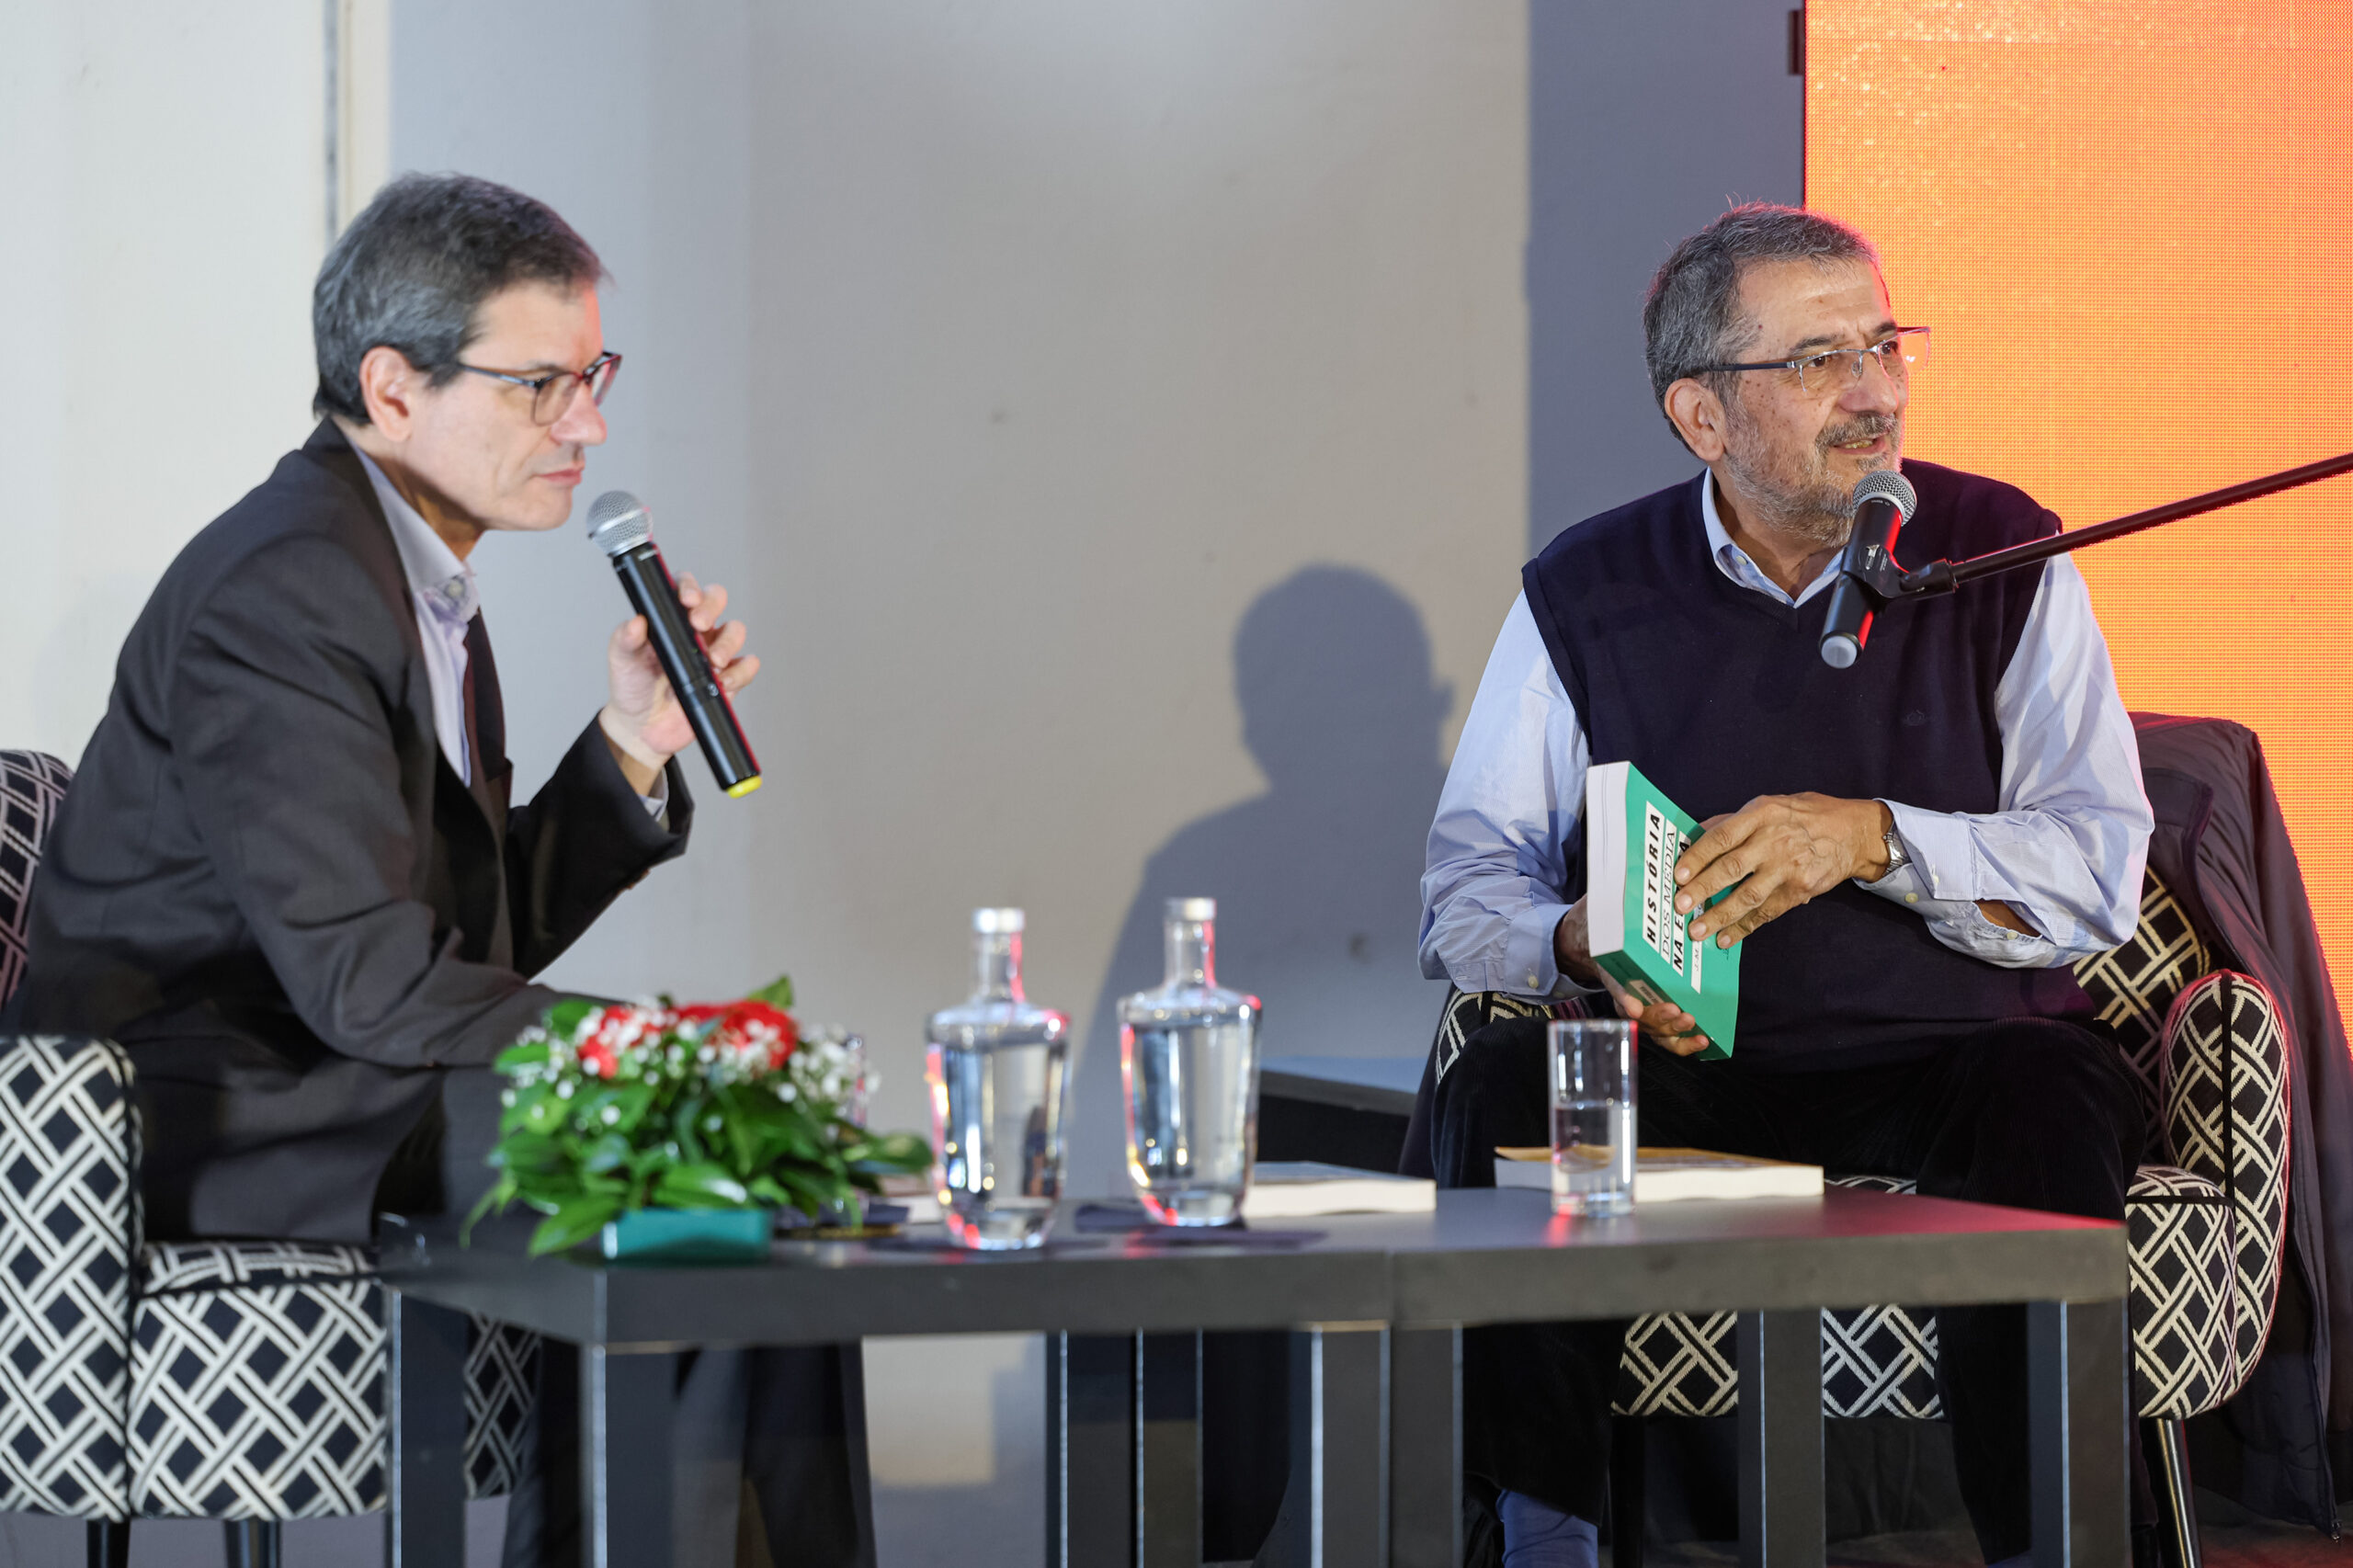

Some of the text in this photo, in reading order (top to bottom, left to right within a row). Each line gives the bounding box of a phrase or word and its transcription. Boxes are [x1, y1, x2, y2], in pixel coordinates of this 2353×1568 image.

[1646, 813, 1660, 945] HISTÓRIA
[1663, 832, 1675, 957] DOS MÉDIA
[1674, 939, 1683, 971] NA
